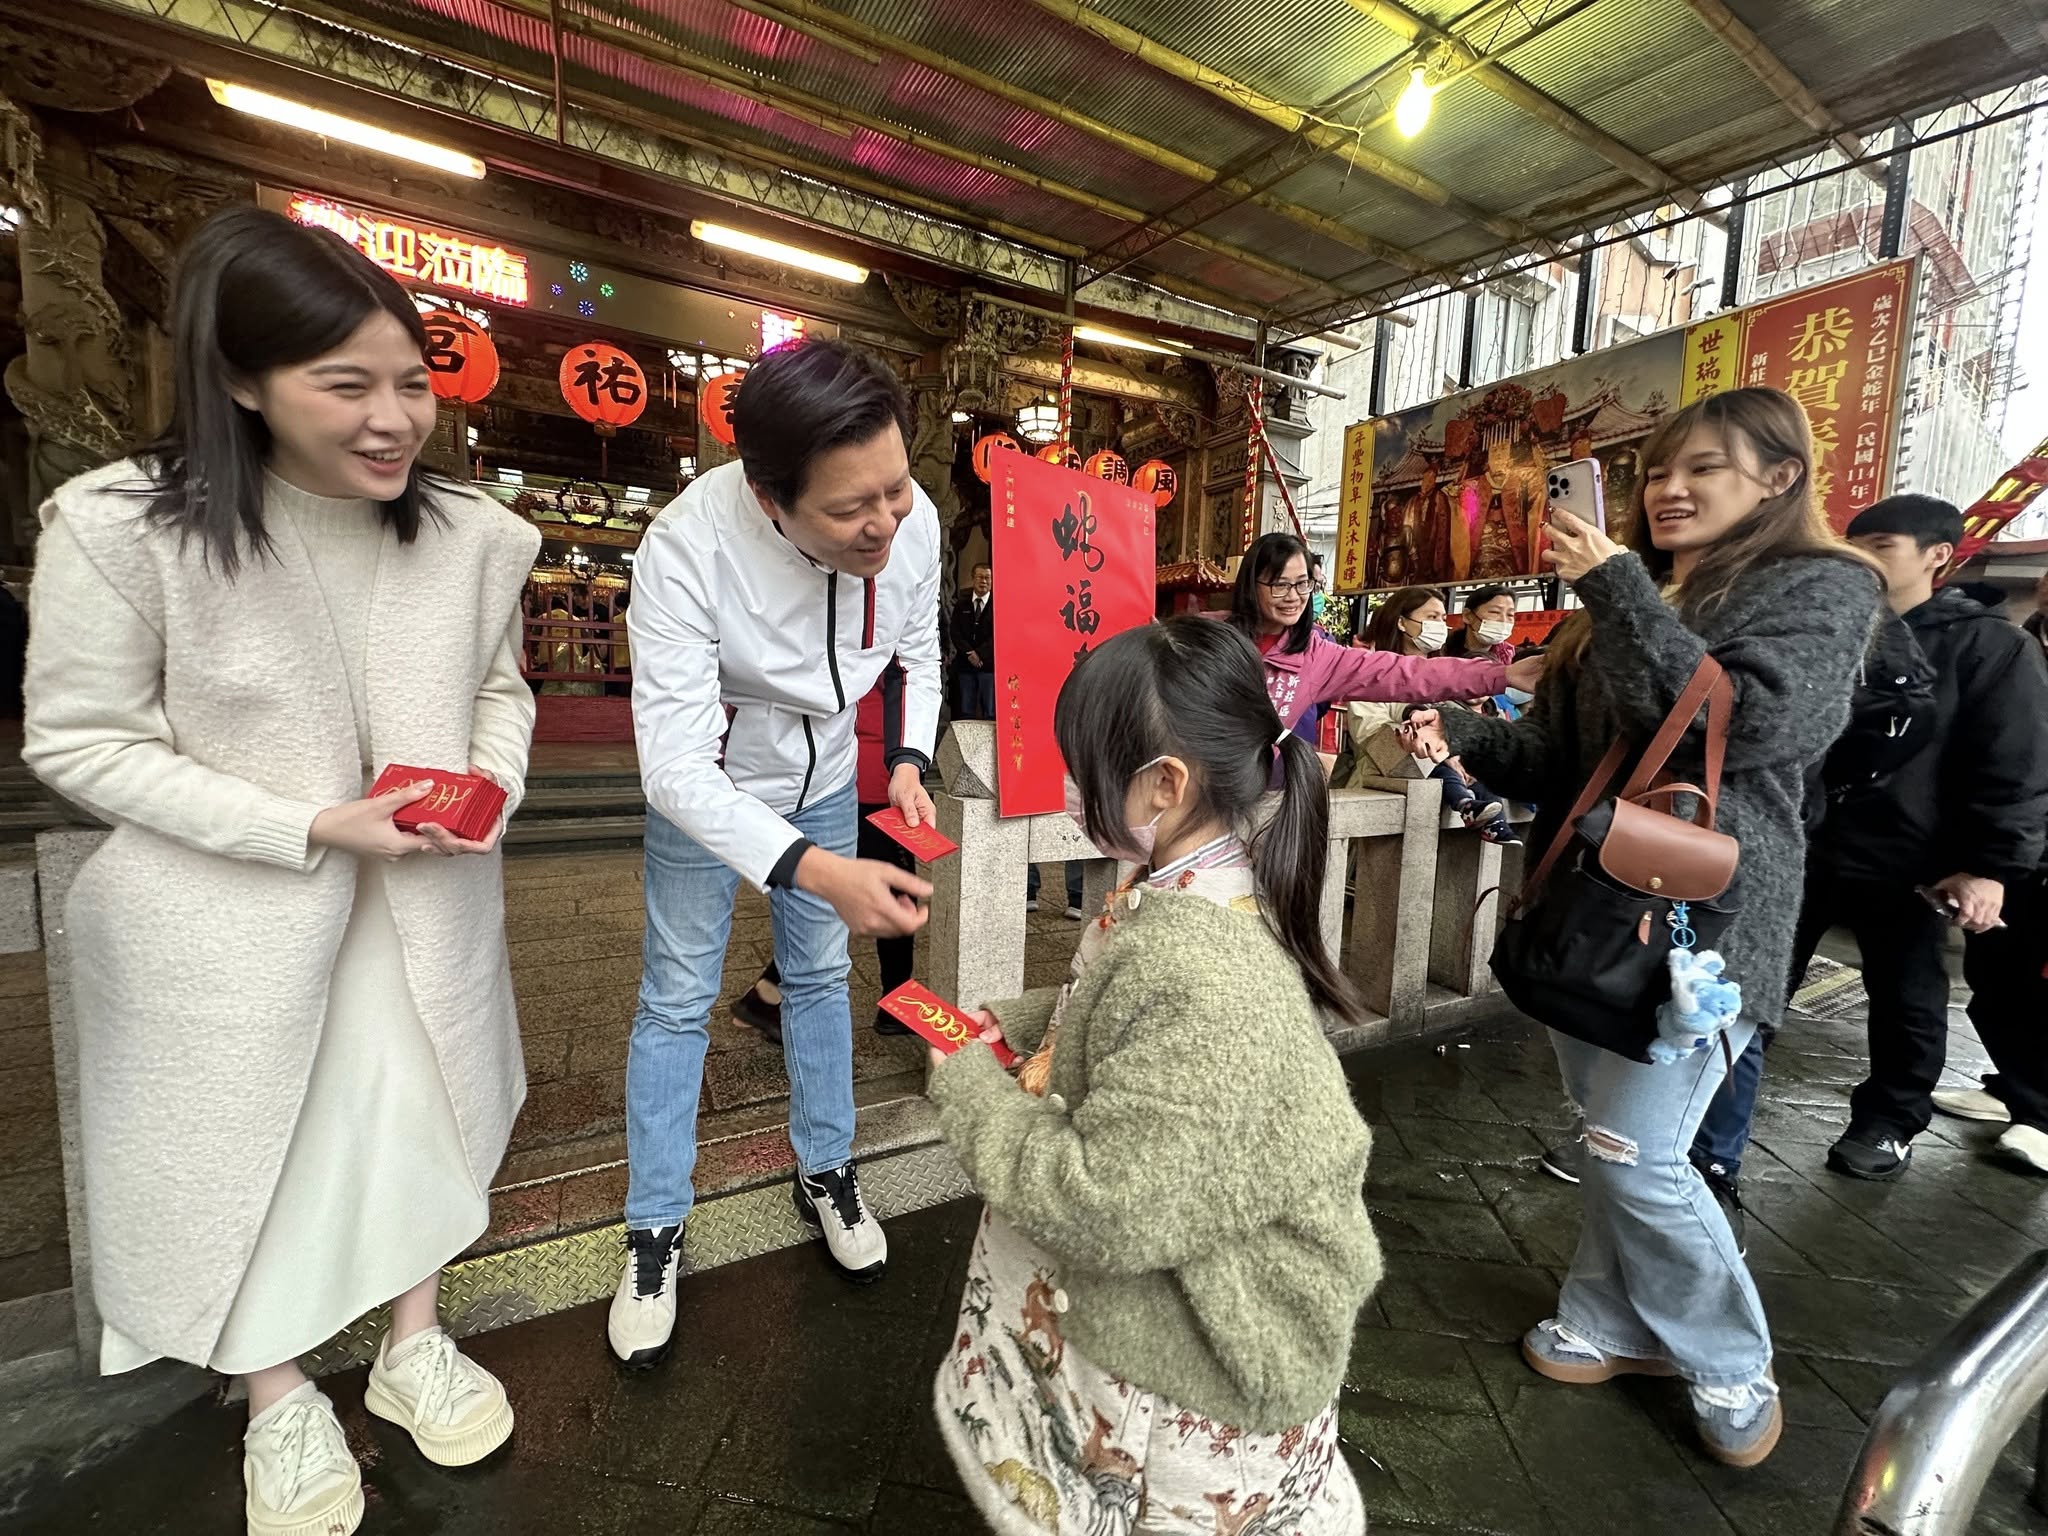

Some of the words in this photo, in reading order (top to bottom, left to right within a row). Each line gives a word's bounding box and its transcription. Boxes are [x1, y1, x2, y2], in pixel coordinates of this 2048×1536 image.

[574, 348, 643, 405] 祐
[1749, 352, 1768, 388] 新莊
[1101, 456, 1128, 487] 調
[1151, 468, 1175, 495] 風
[1052, 489, 1104, 666] 蛇福
[1278, 675, 1300, 717] 新莊區
